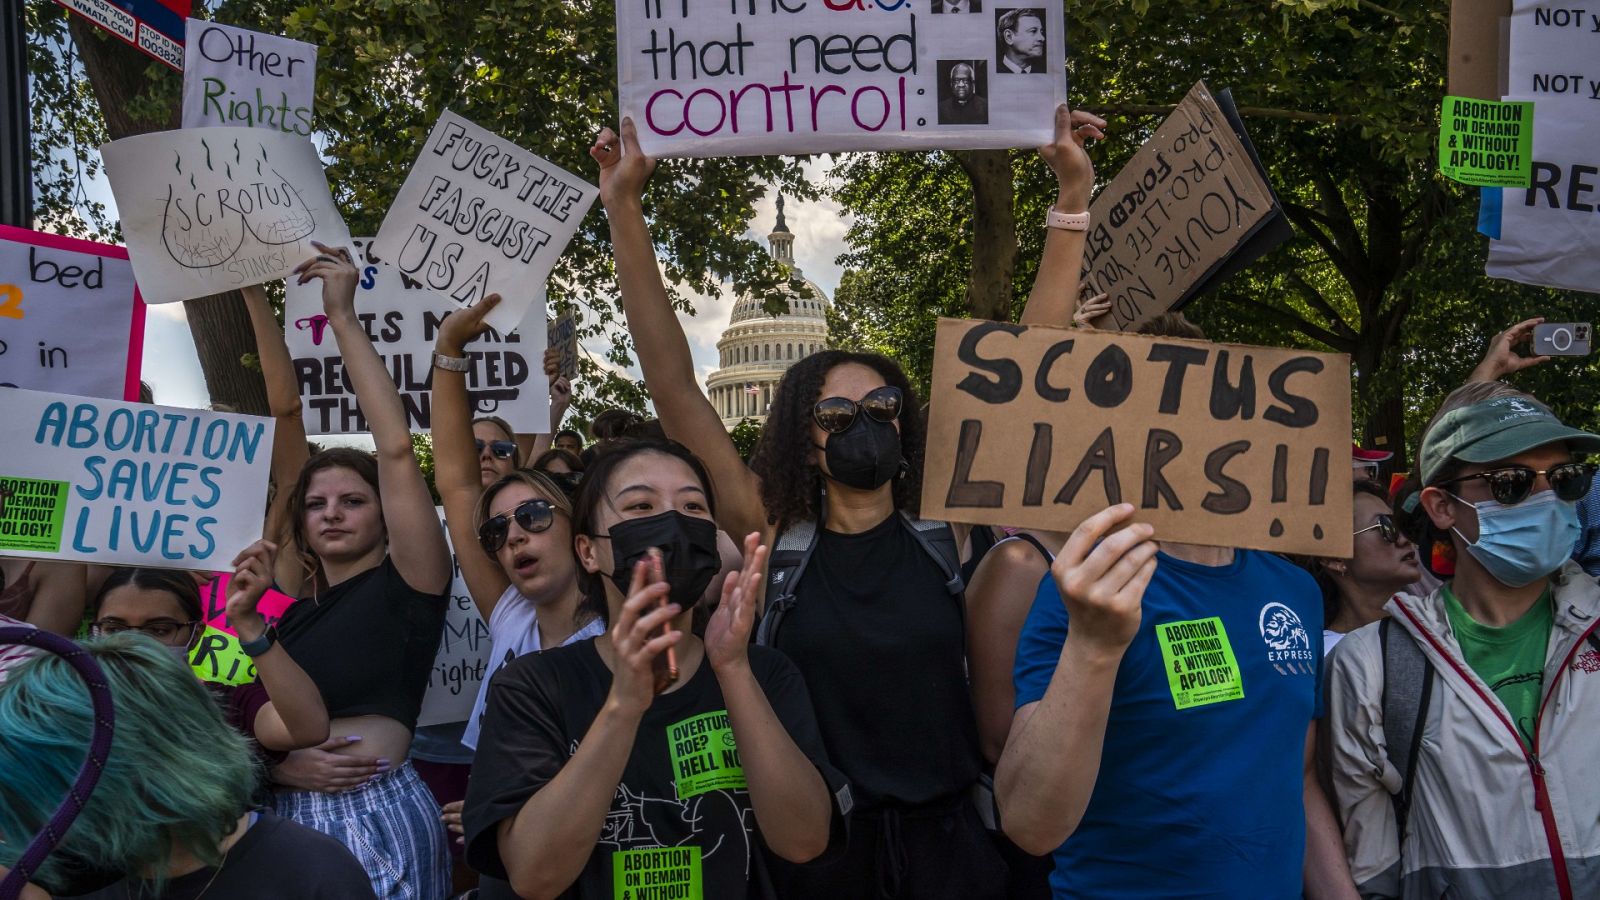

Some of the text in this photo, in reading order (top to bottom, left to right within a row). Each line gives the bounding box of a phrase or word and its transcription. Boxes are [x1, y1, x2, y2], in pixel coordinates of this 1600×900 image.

[73, 0, 134, 39] WMATA.COM
[1535, 7, 1586, 27] NOT
[140, 24, 160, 41] STOP
[161, 38, 170, 48] ID
[140, 36, 181, 67] 1003824
[641, 13, 919, 81] that need
[199, 27, 305, 78] Other
[1533, 73, 1584, 94] NOT
[202, 77, 311, 136] Rights
[645, 70, 927, 137] control:
[1452, 100, 1523, 121] ABORTION
[1448, 133, 1519, 153] & WITHOUT
[1453, 118, 1520, 137] ON DEMAND
[433, 122, 584, 224] FUCK THE
[1449, 150, 1520, 171] APOLOGY!
[1525, 162, 1600, 212] RE
[175, 181, 292, 231] SCROTUS
[419, 176, 551, 264] FASCIST
[29, 246, 103, 290] bed
[399, 224, 491, 308] USA
[1110, 275, 1157, 331] NOT
[359, 311, 404, 343] IS
[38, 341, 68, 369] in
[293, 350, 529, 396] REULTED
[956, 320, 1325, 428] SCOTUS
[309, 391, 432, 433] THN
[34, 401, 265, 465] ABORTION
[0, 479, 60, 497] BORTION
[75, 455, 223, 510] SAVES
[945, 419, 1330, 541] LIARS!!
[72, 505, 218, 560] LIVES
[1165, 620, 1218, 643] ABORTION
[1171, 637, 1222, 657] ON DEMAND
[1173, 651, 1227, 674] & WITHOUT
[1267, 650, 1313, 662] EXPRESS
[1179, 666, 1235, 691] APOLOGY!
[673, 714, 731, 742] OVERTUR
[675, 734, 709, 758] ROE?
[678, 752, 720, 779] HELL
[624, 849, 691, 871] ABORTION
[625, 868, 691, 887] ON DEMAND
[636, 883, 691, 900] WITHOUT
